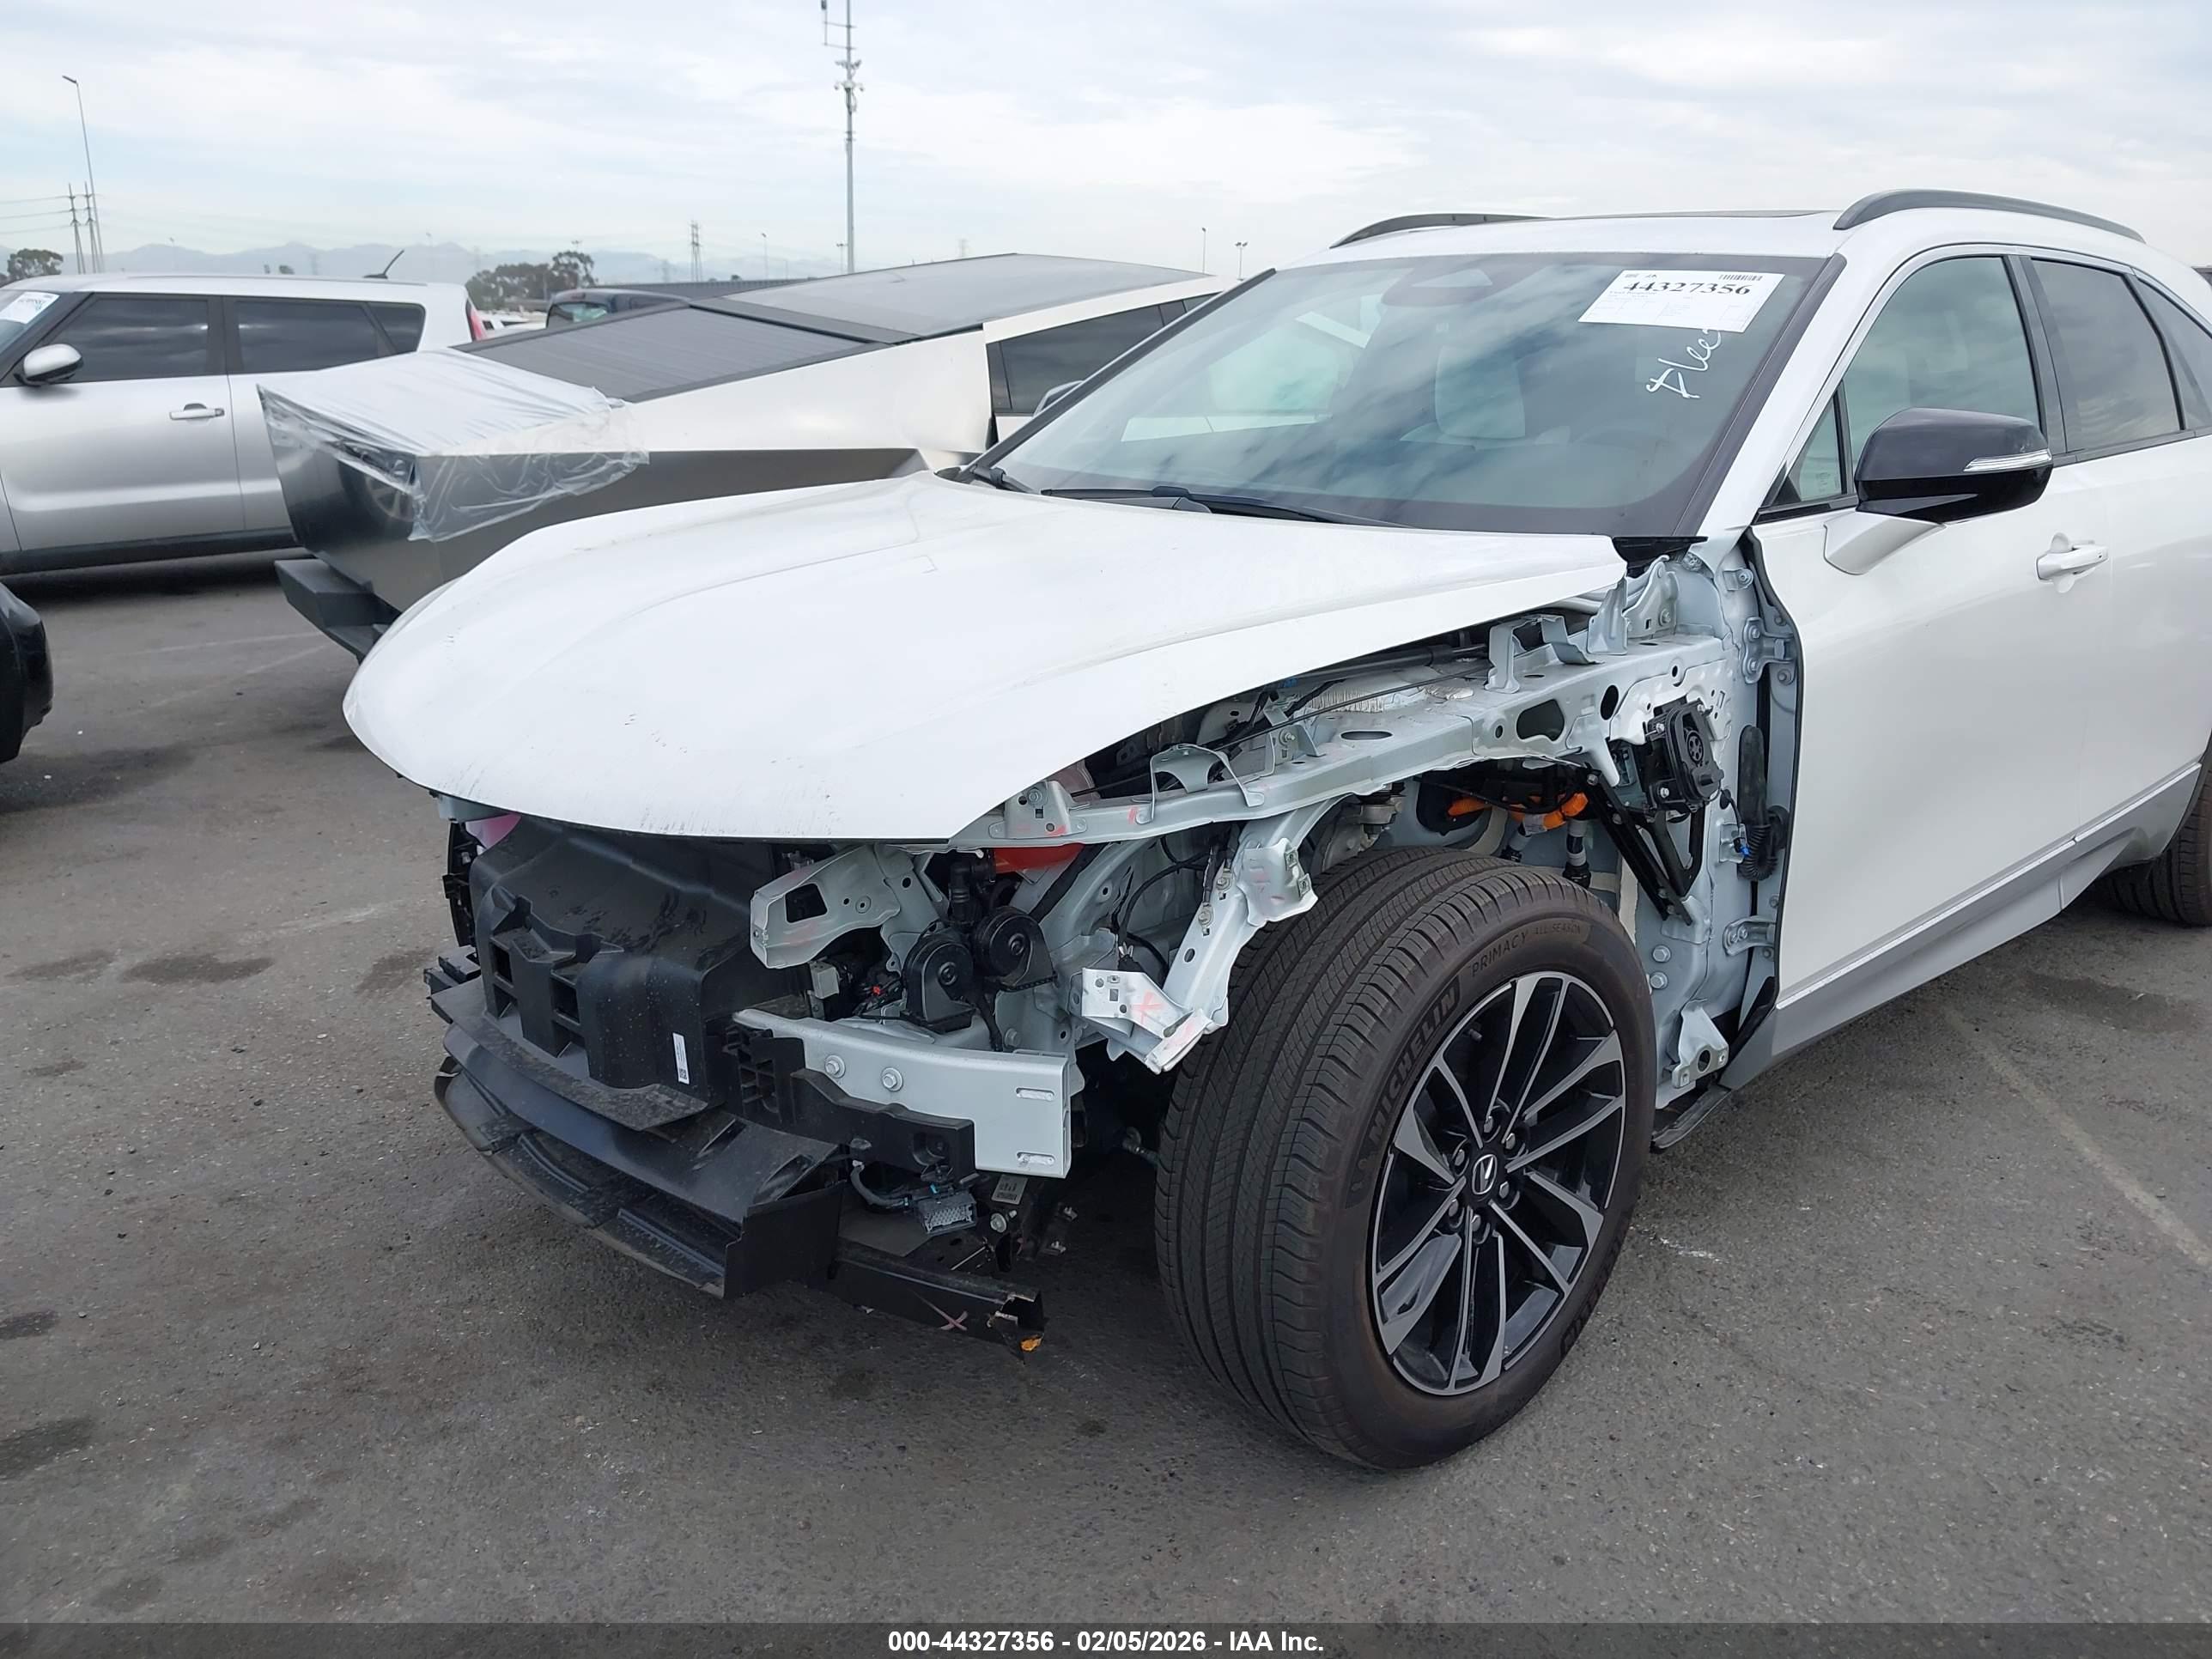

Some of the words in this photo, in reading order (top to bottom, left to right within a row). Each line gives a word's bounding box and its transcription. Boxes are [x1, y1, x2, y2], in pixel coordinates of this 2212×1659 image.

[1623, 281, 1753, 295] 44327356
[1470, 930, 1528, 978] PRIMACY
[1369, 986, 1457, 1144] MICHELIN
